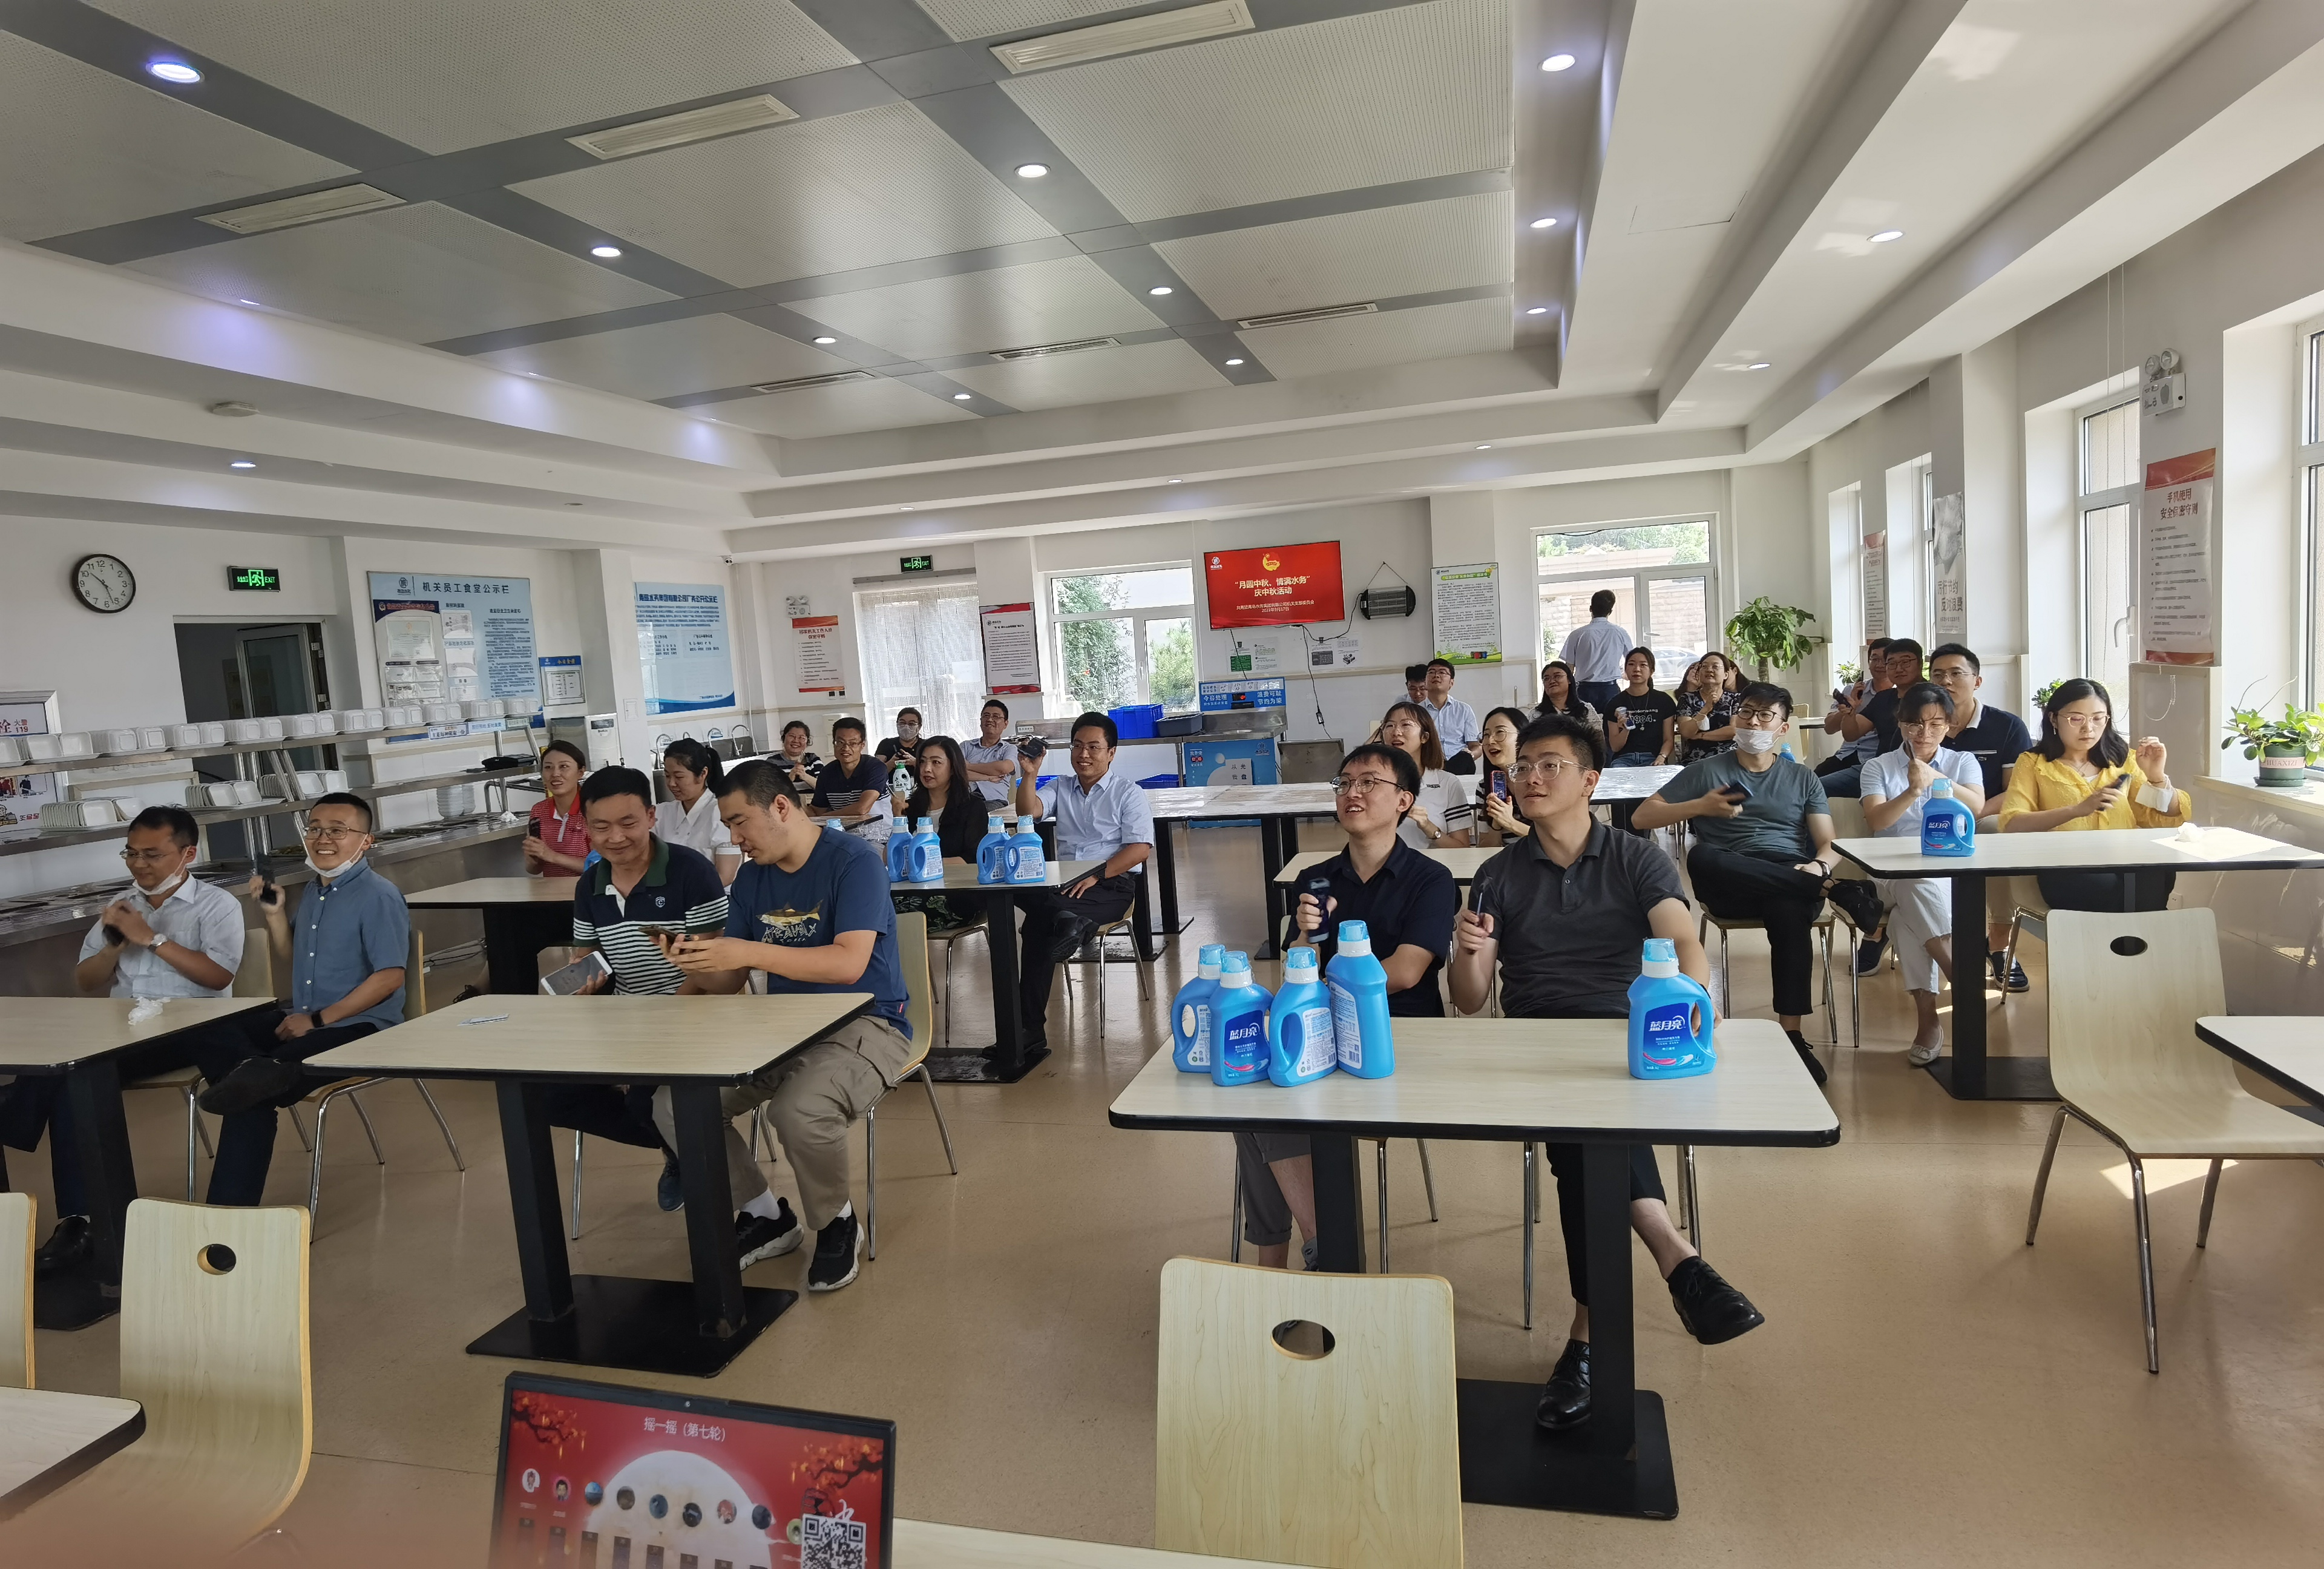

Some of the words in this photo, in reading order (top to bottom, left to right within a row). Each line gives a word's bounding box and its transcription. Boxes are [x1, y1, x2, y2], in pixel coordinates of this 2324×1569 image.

[2167, 488, 2191, 503] 手机使用
[422, 582, 510, 594] 机关员工食堂公示栏
[1254, 586, 1292, 597] 庆中秋活动
[1938, 579, 1958, 594] 厉行节约
[1942, 596, 1963, 612] 反对浪费
[1649, 1016, 1684, 1031] 蓝月亮
[1229, 1023, 1259, 1041] 蓝月亮
